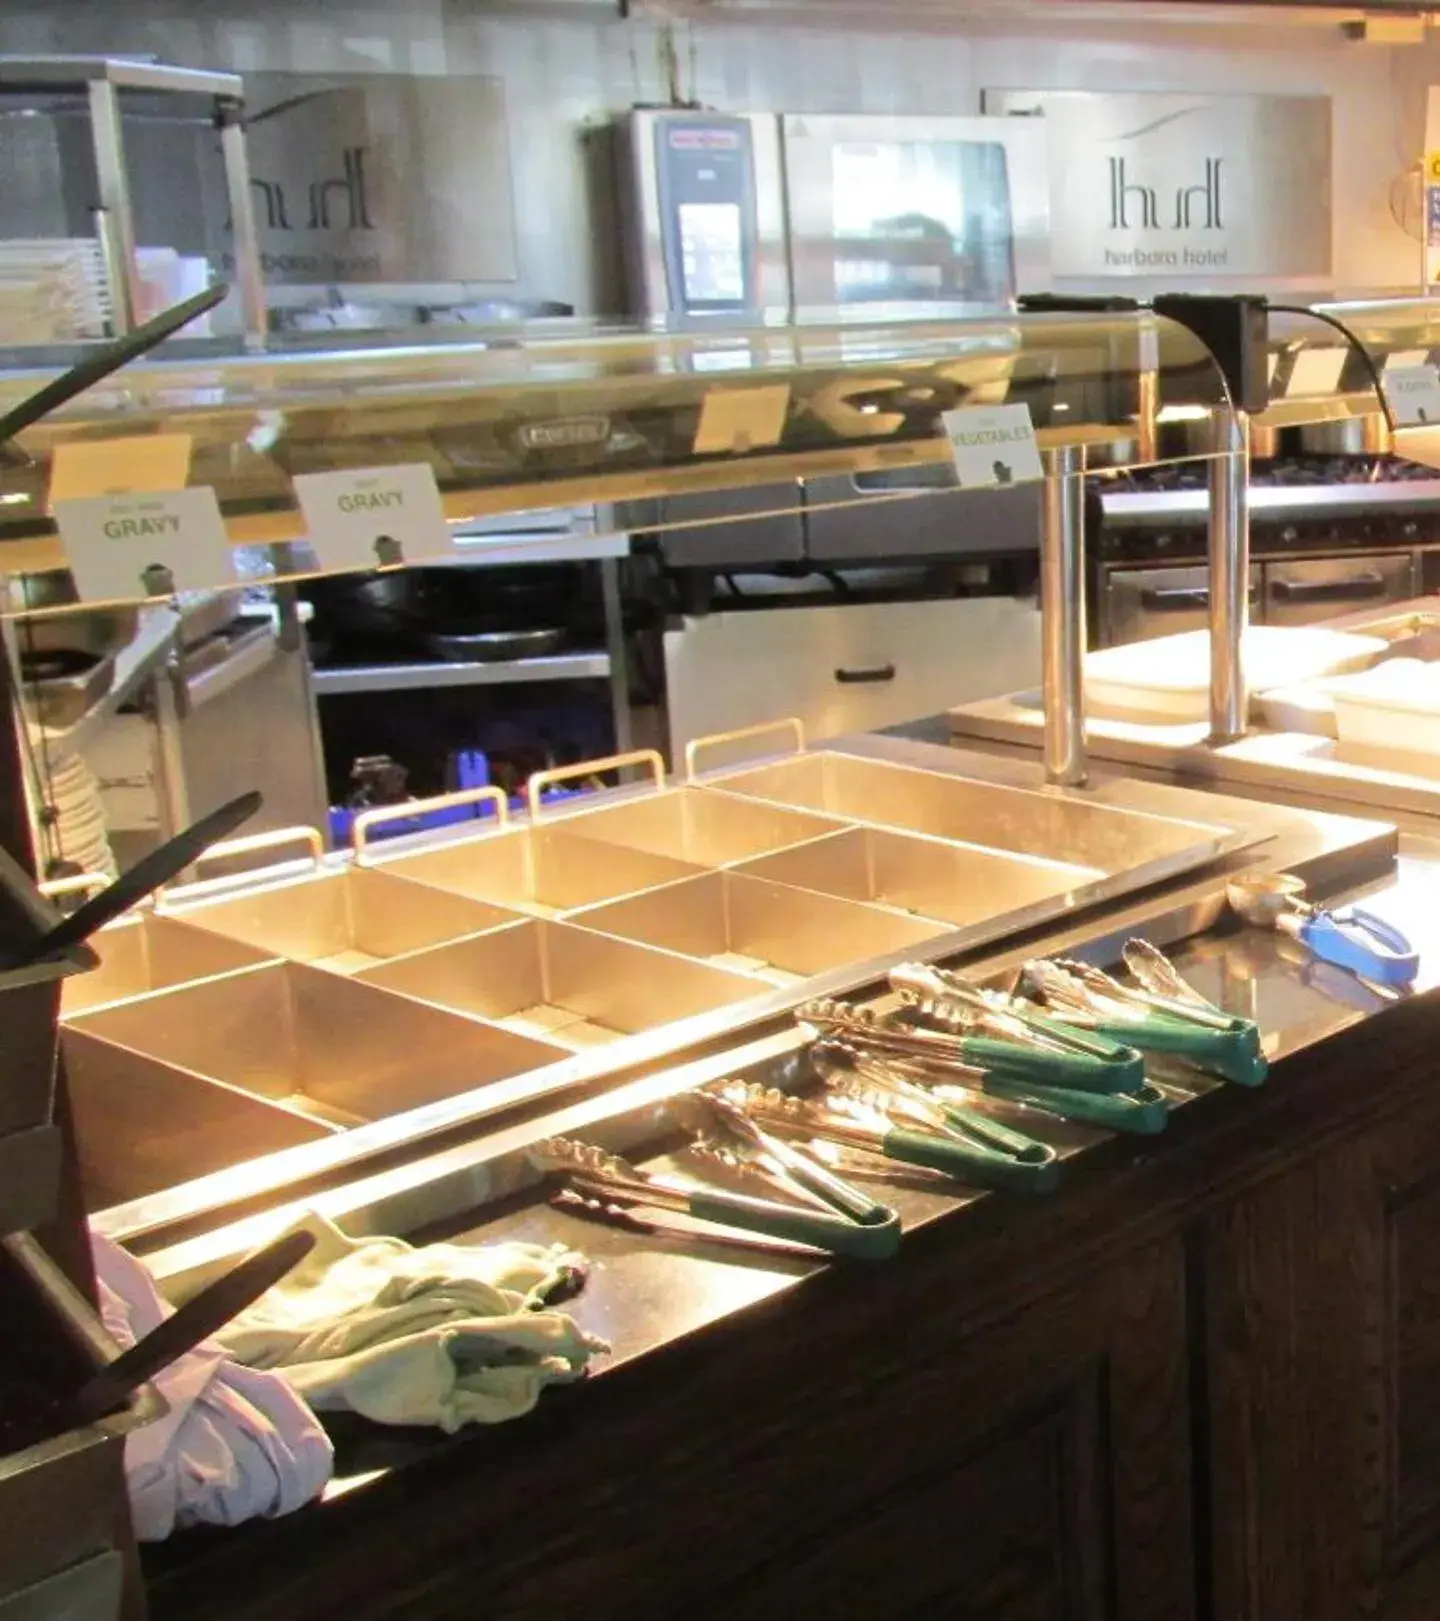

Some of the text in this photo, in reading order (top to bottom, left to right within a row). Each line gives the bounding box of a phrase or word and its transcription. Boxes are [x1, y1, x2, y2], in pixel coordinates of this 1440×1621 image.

[1183, 247, 1228, 268] hotel
[337, 490, 404, 513] GRAVY
[103, 514, 180, 539] GRAVY
